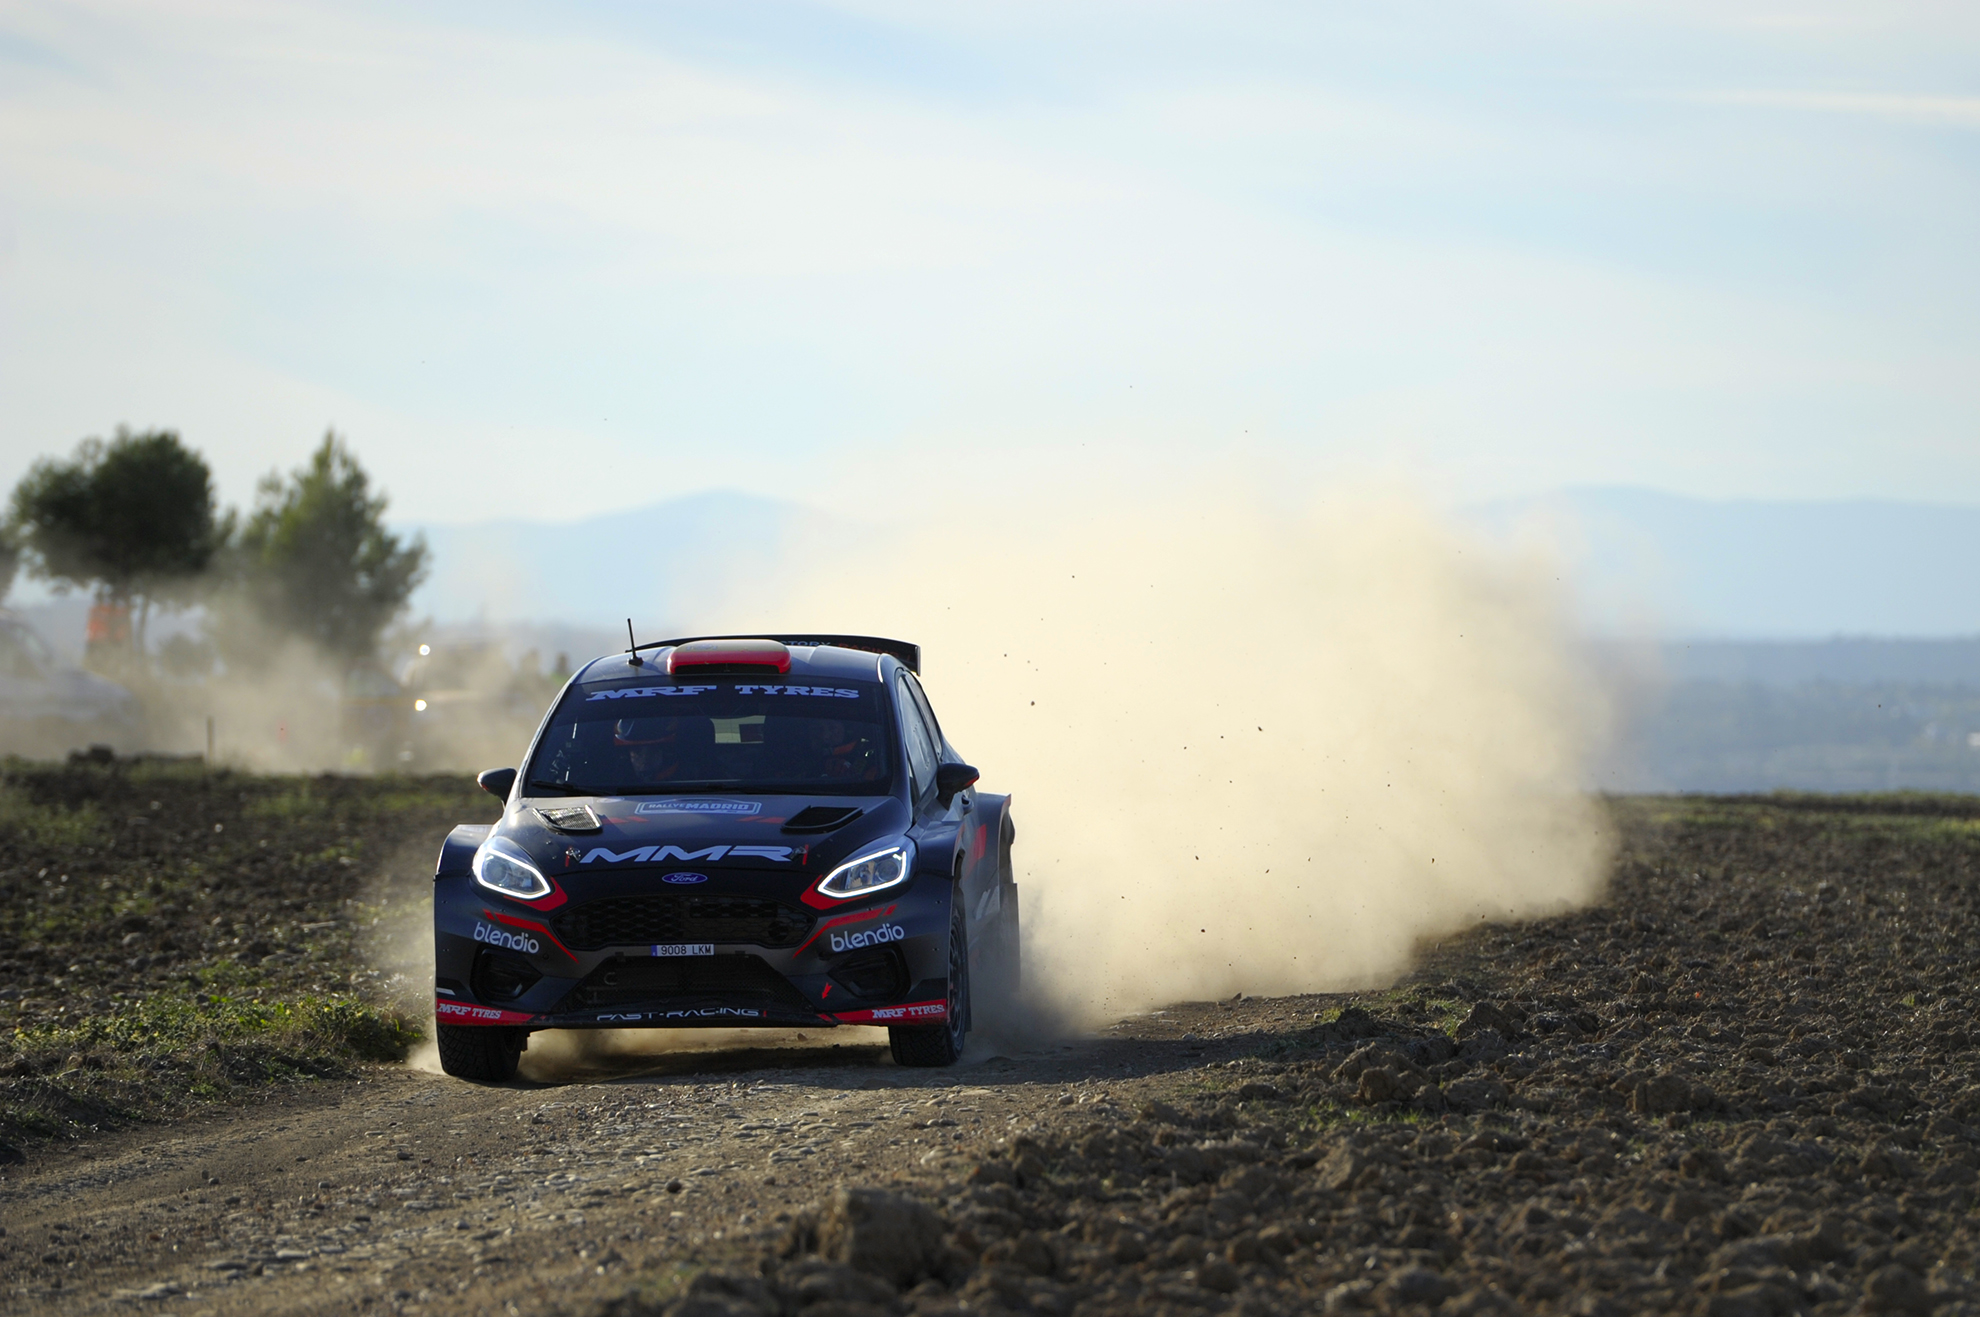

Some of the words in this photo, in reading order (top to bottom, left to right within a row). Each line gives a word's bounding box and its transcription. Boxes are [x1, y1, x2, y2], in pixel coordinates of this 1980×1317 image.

[585, 685, 718, 701] MRF
[734, 685, 860, 699] TYRES
[579, 845, 793, 863] MMR
[671, 874, 699, 882] Ford
[473, 921, 540, 954] blendio
[830, 922, 905, 953] blendio
[660, 945, 687, 956] 9008
[692, 944, 712, 955] LKM
[436, 1003, 471, 1016] MRF
[472, 1007, 502, 1019] TYRES
[872, 1009, 907, 1019] MRF
[908, 1004, 945, 1016] TYRES
